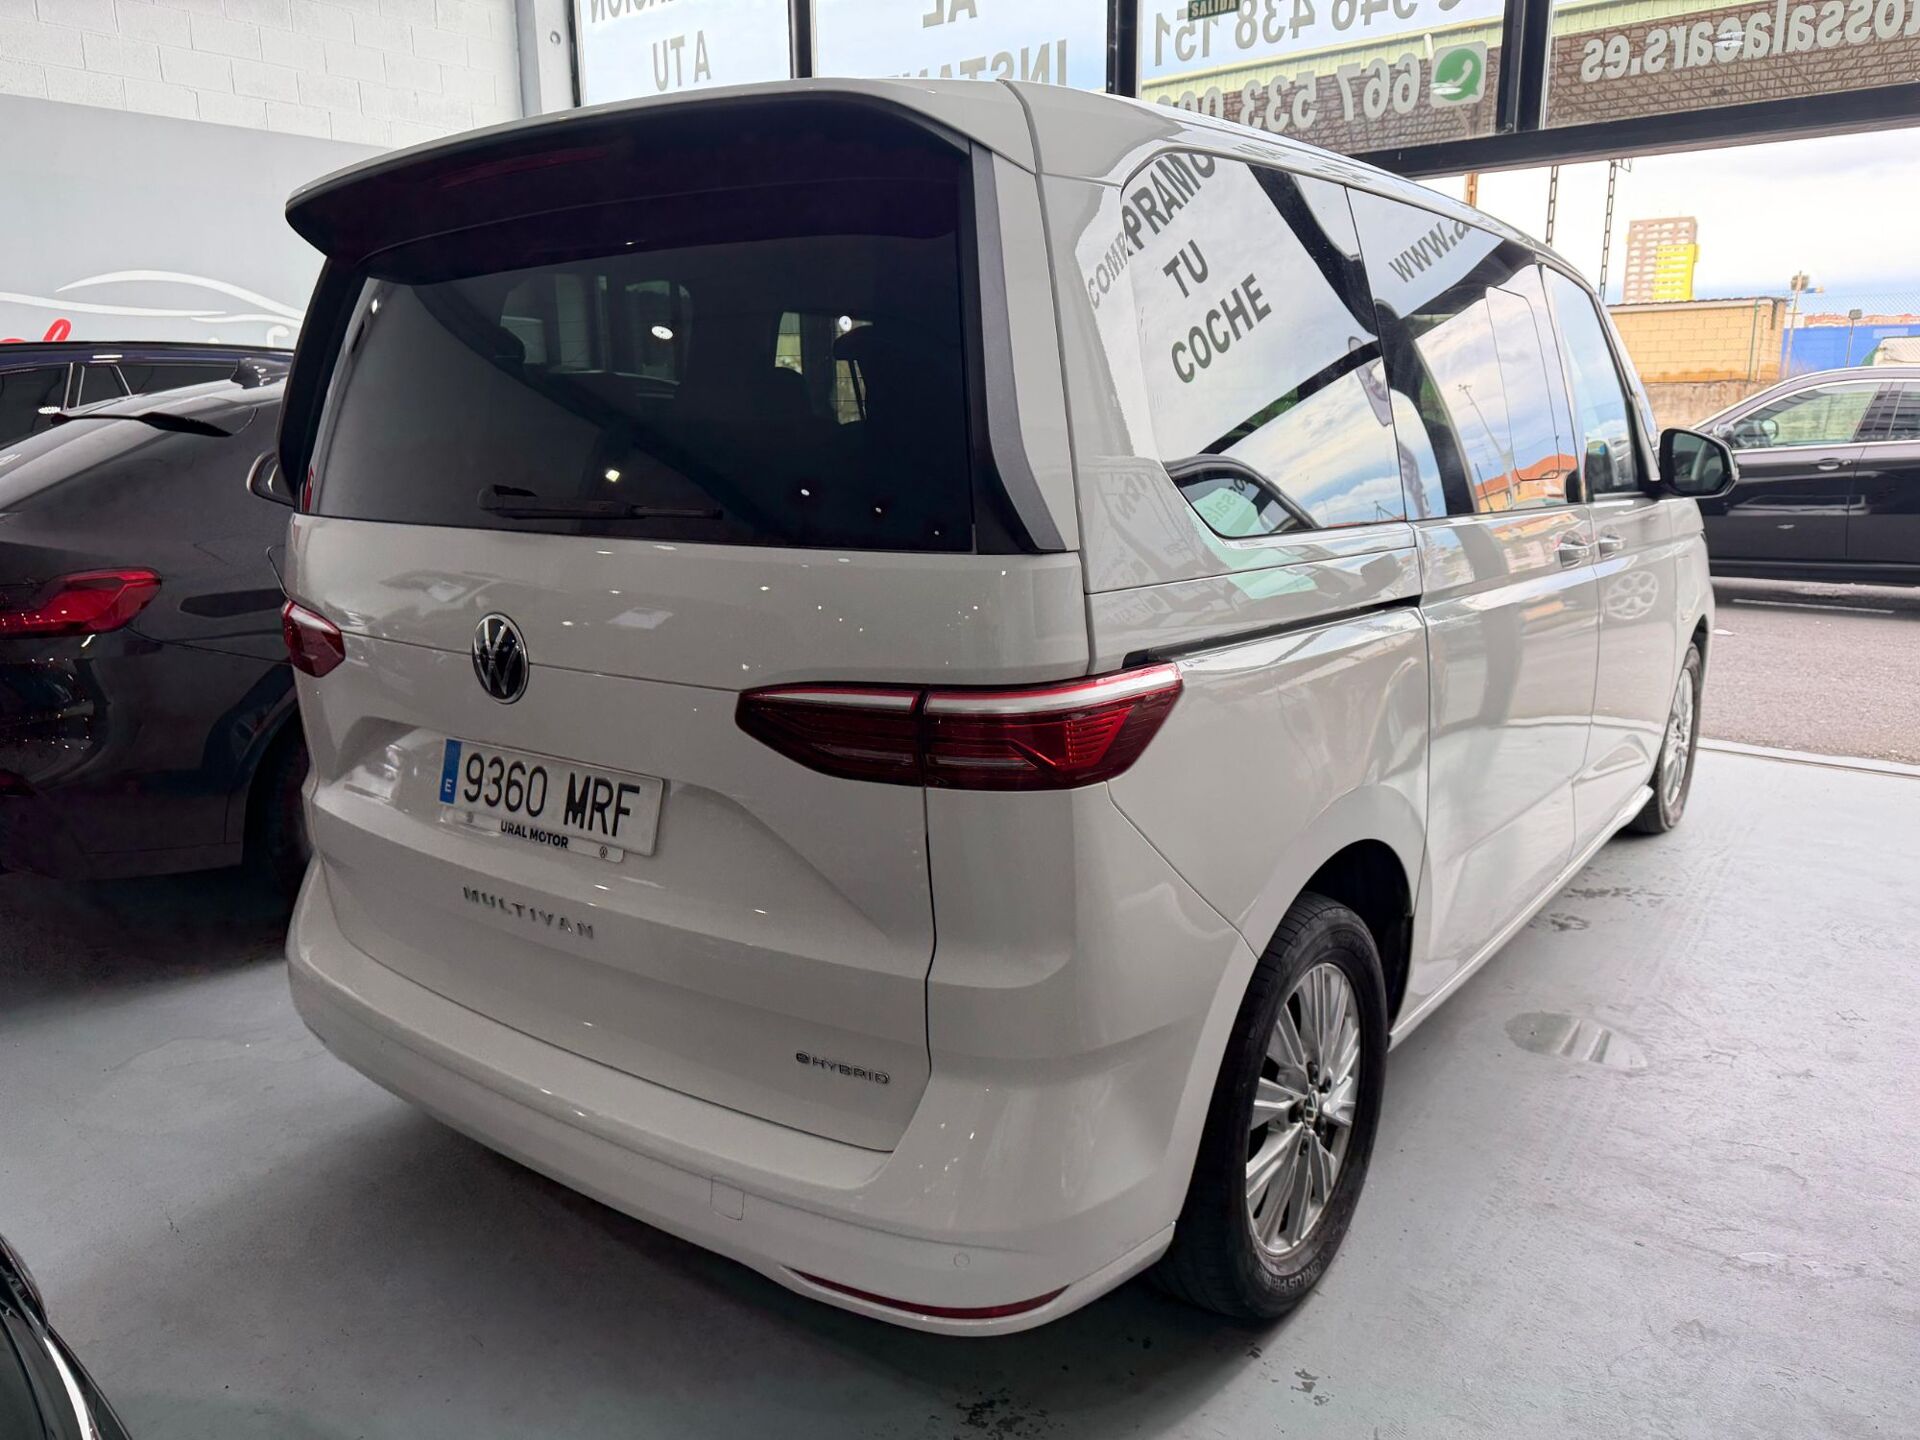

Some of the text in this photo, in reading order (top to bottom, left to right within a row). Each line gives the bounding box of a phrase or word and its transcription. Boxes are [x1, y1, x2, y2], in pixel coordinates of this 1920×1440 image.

[1191, 0, 1236, 17] SALIDA
[1162, 240, 1209, 298] TU
[1171, 274, 1272, 384] COCHE
[445, 752, 641, 837] E 9360 MRF
[500, 820, 569, 849] URAL MOTOR
[463, 885, 595, 940] MULTIVAN
